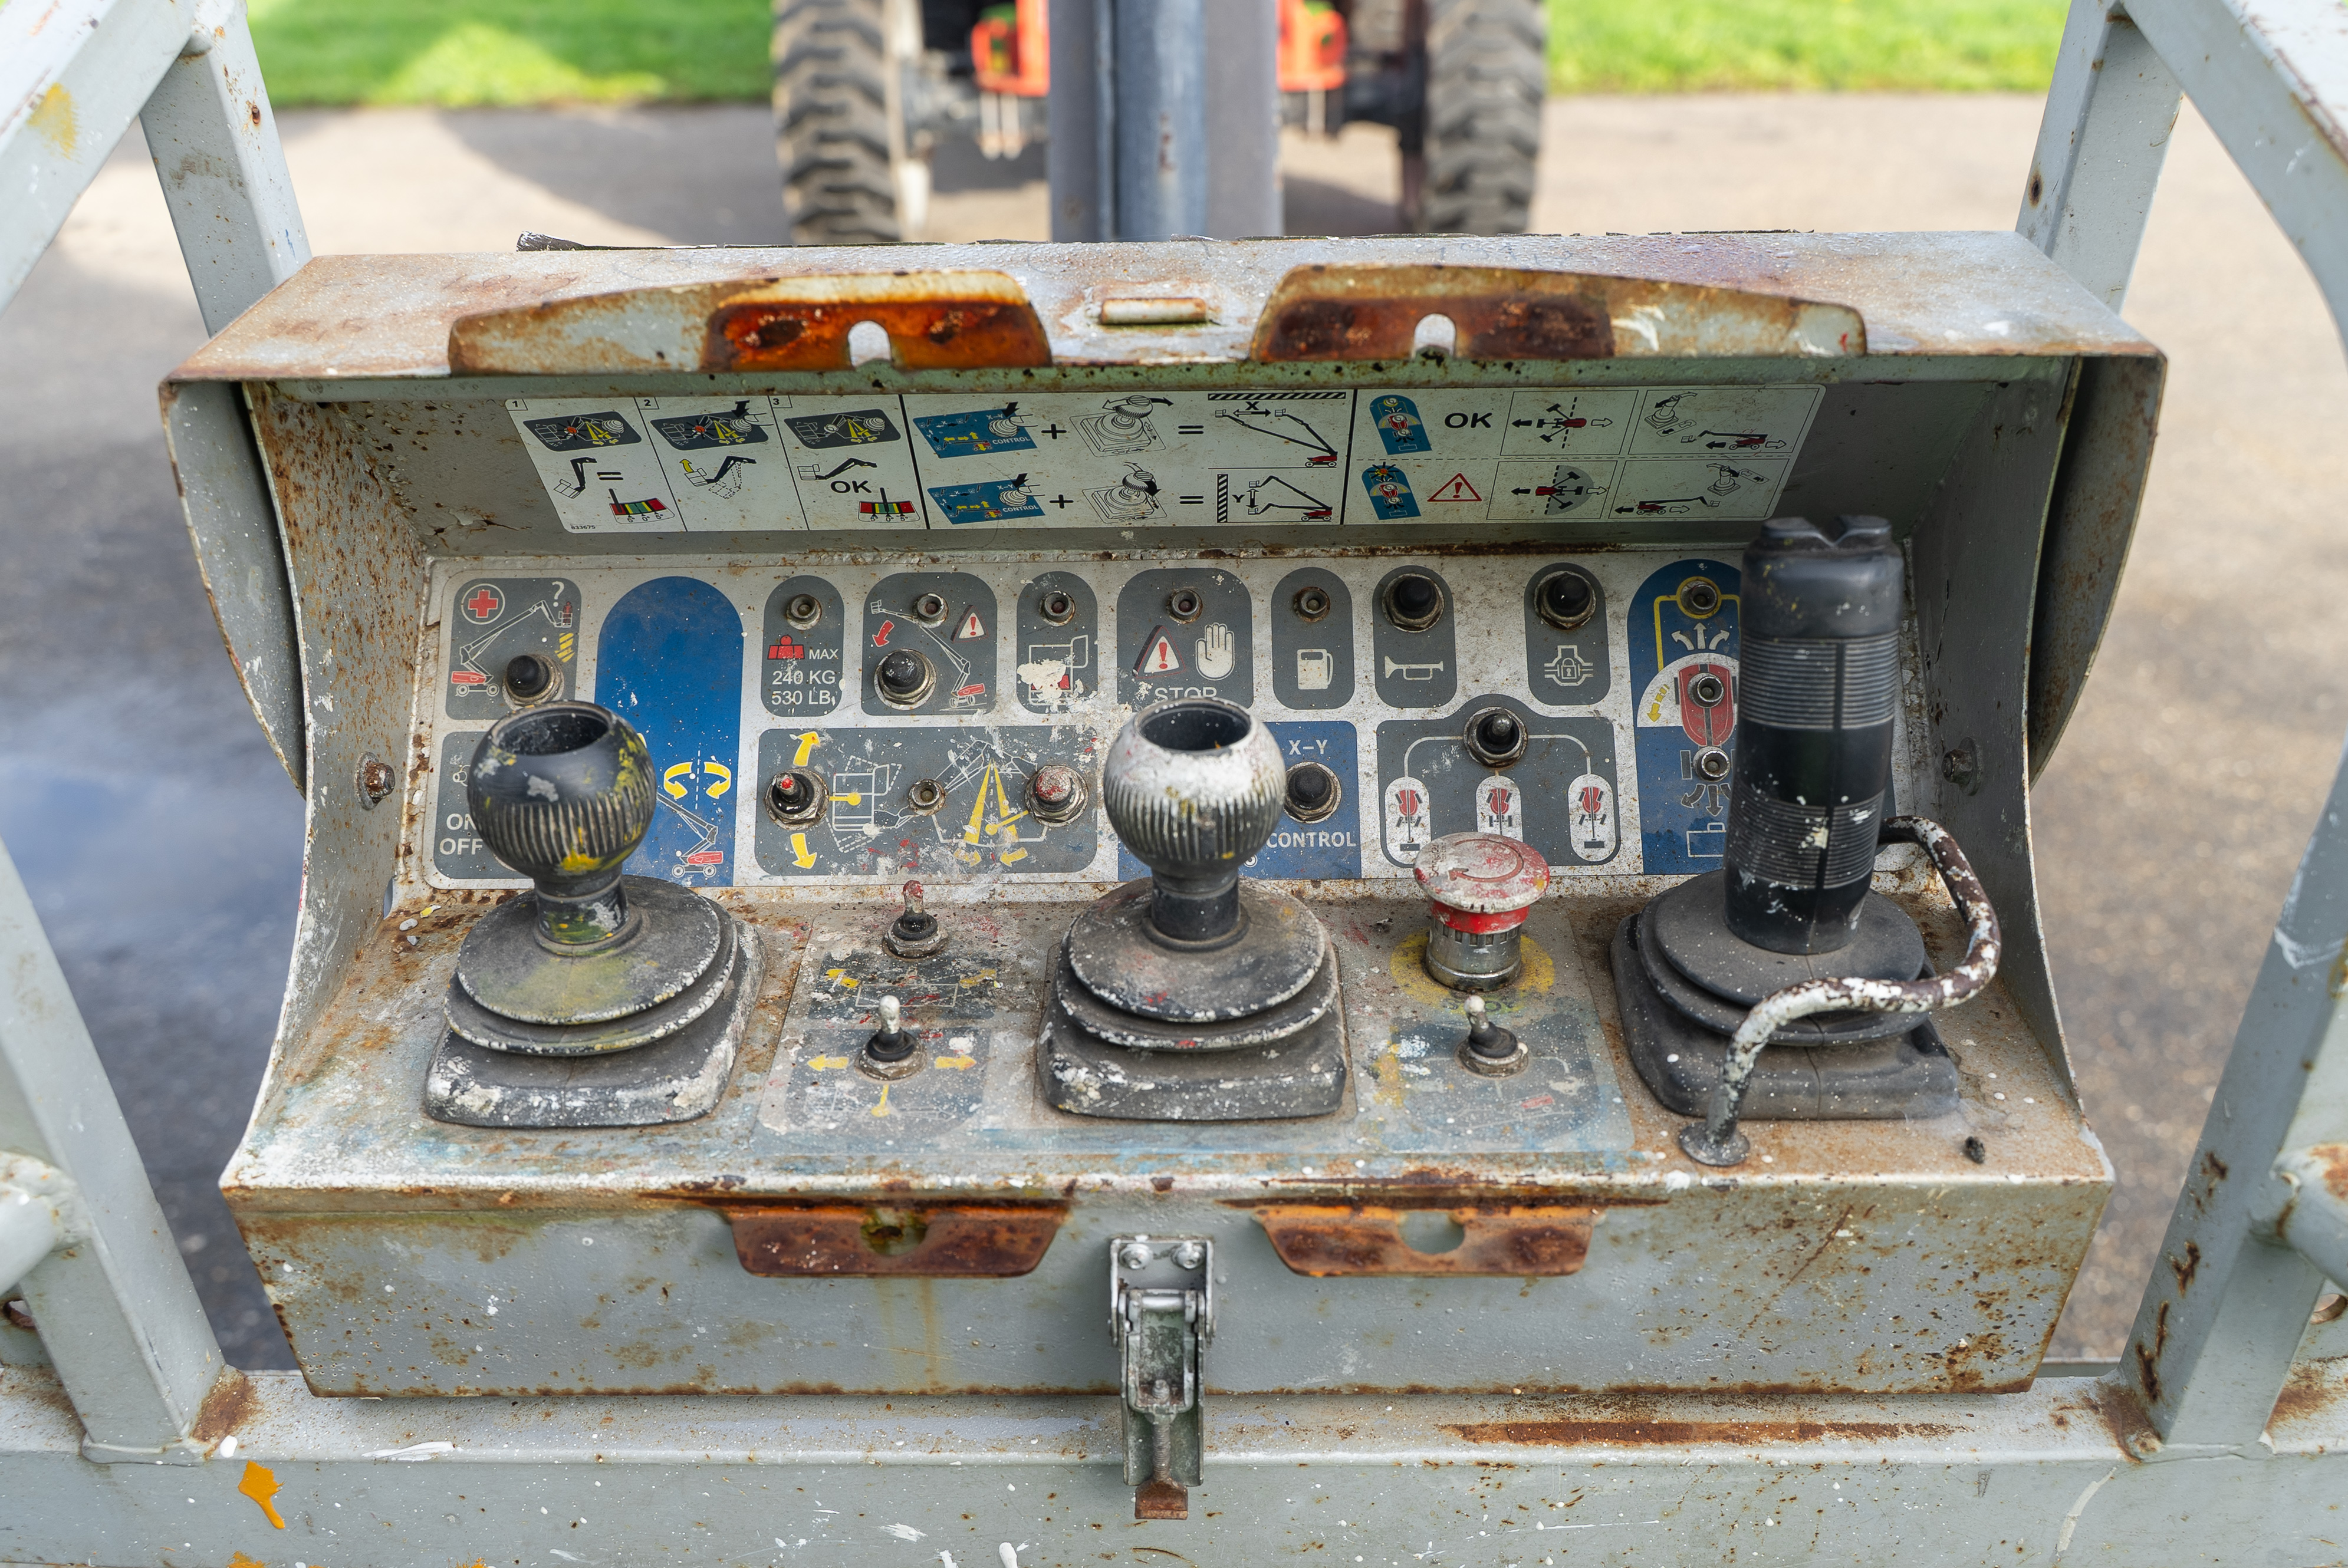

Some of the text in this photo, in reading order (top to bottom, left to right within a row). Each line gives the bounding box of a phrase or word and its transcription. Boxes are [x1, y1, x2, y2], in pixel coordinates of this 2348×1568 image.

[644, 399, 651, 407] 2
[773, 398, 780, 406] 3
[1245, 401, 1259, 411] X
[1445, 413, 1492, 429] OK
[992, 436, 1031, 445] CONTROL
[830, 480, 872, 493] OK
[1232, 494, 1245, 503] Y
[1002, 505, 1039, 513] CONTROL
[809, 648, 839, 660] MAX
[772, 670, 836, 685] 240 KG
[771, 690, 831, 705] 530 LB
[1155, 686, 1217, 701] STOP
[1288, 739, 1328, 755] X-Y
[1266, 831, 1357, 848] CONTROL
[439, 838, 484, 855] OFF
